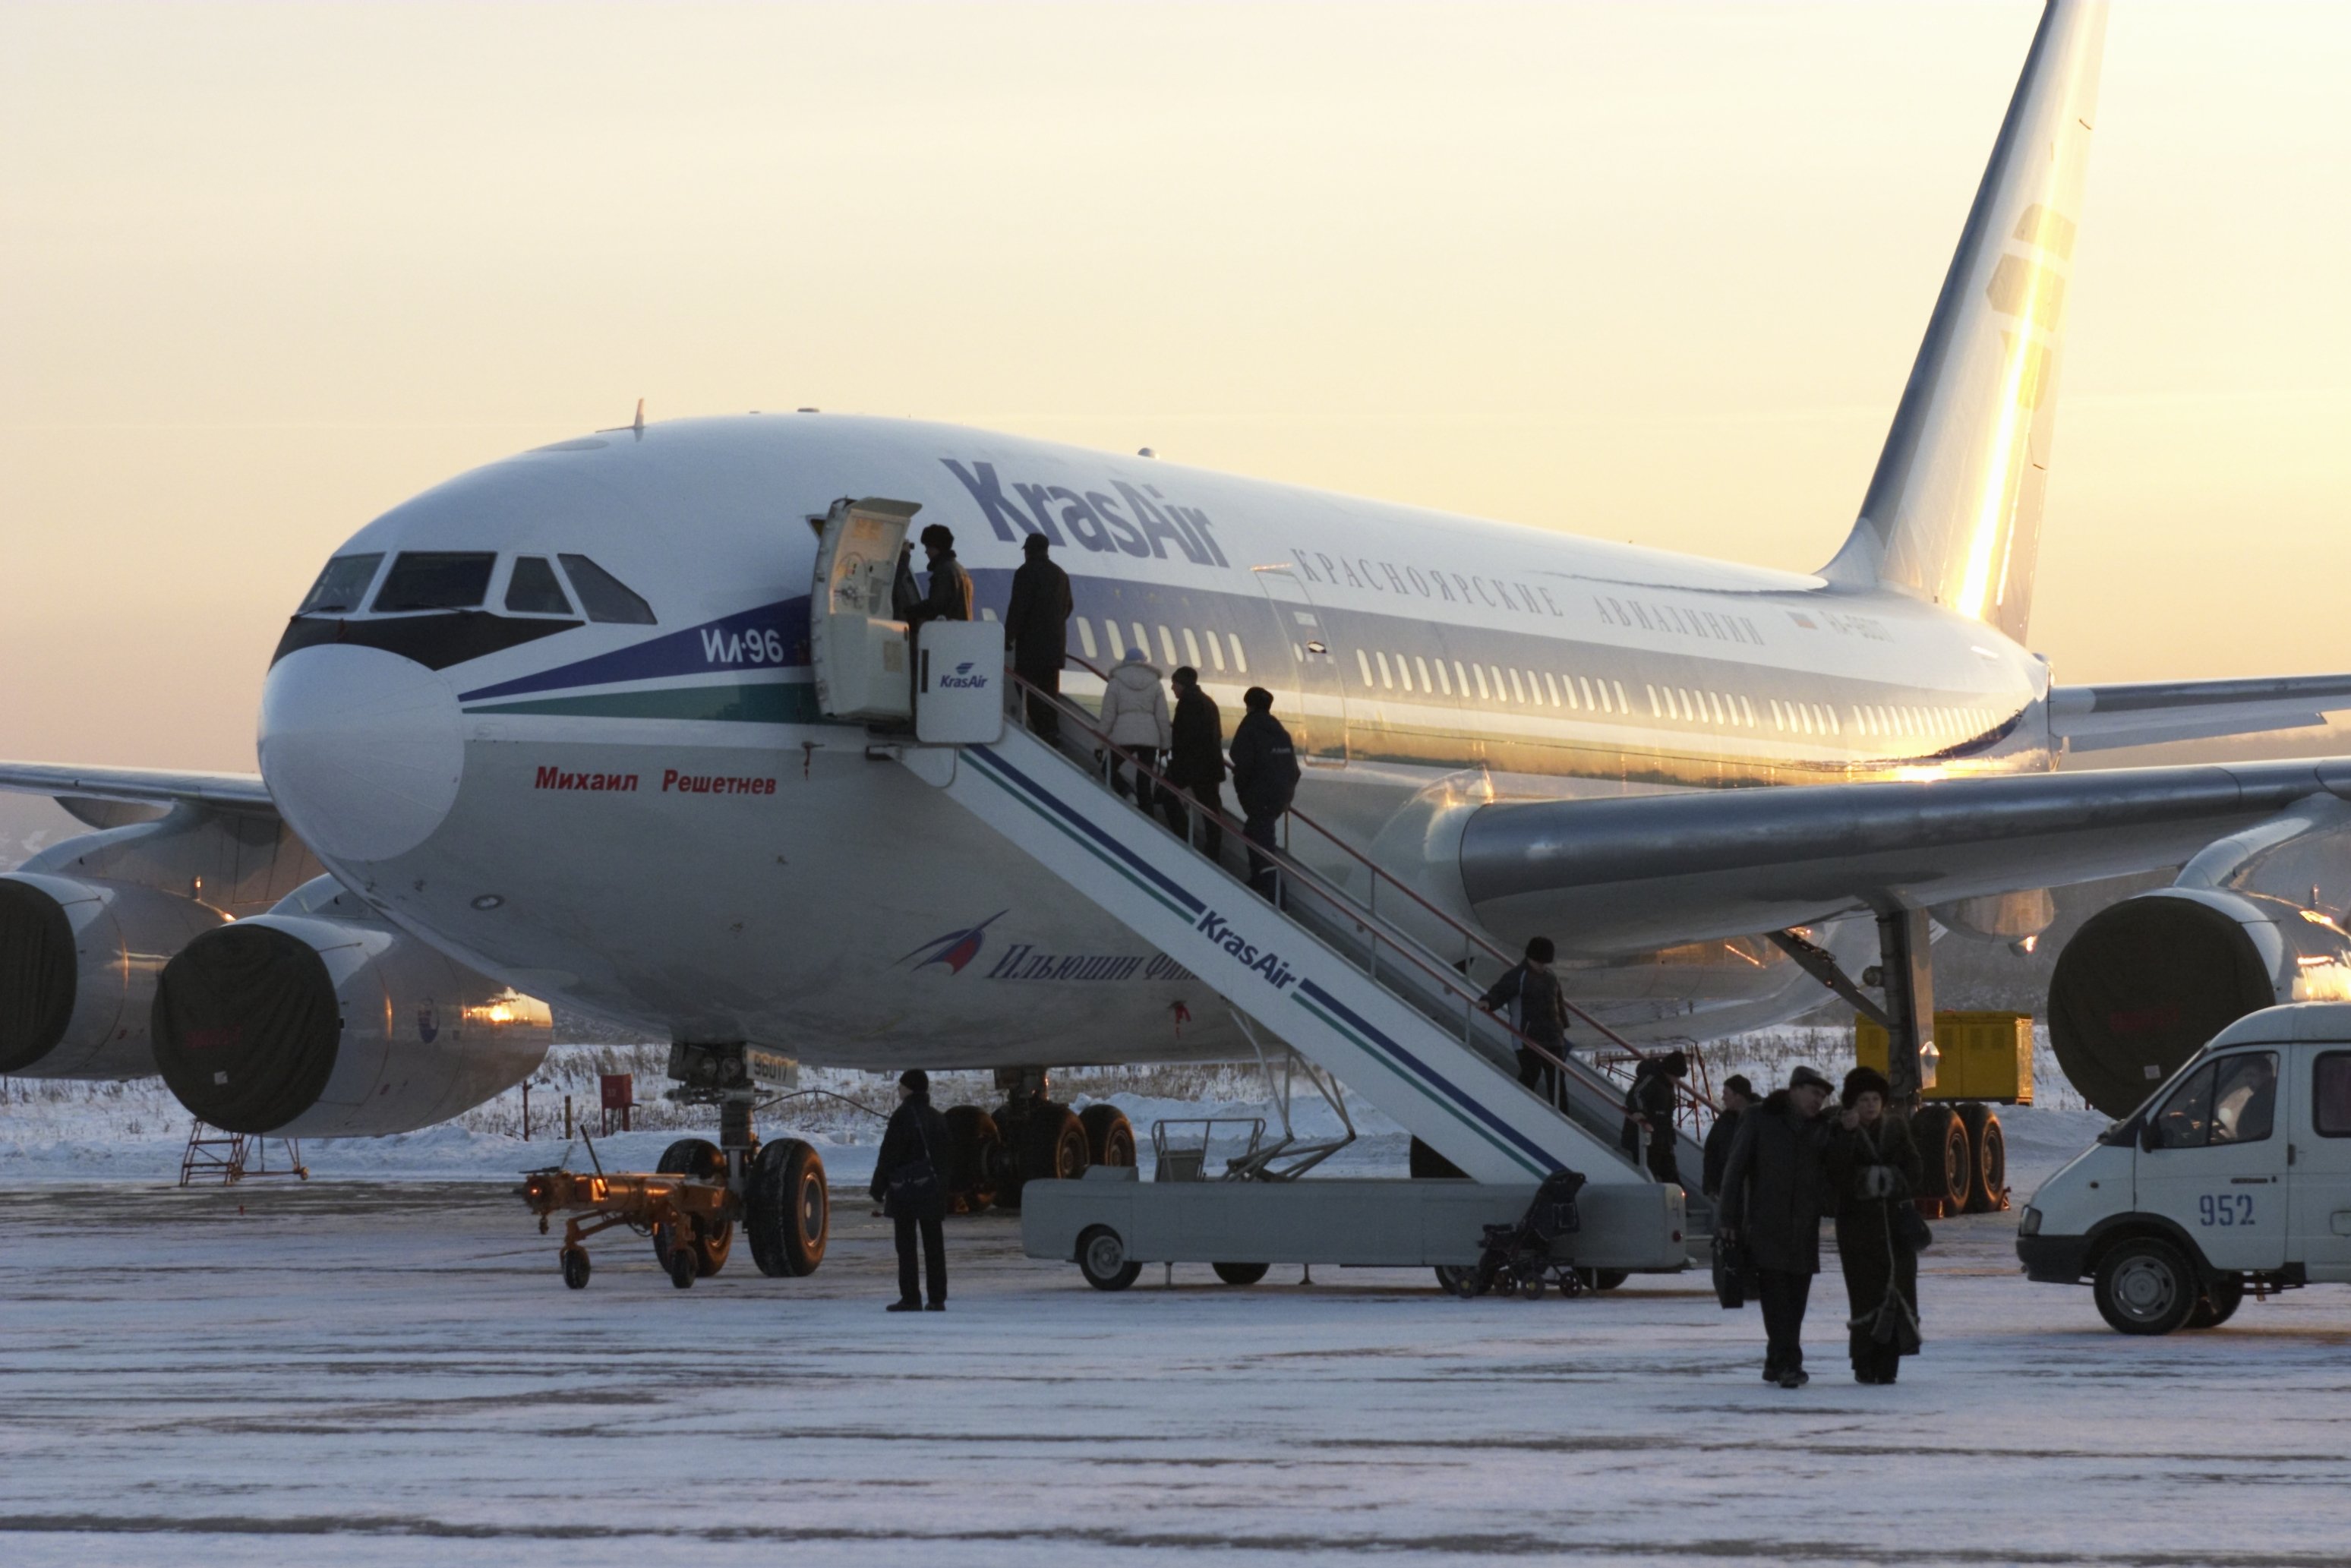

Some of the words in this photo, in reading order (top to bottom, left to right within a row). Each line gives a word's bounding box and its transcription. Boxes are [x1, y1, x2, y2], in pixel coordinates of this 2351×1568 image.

[939, 458, 1230, 568] KrasAir
[1290, 548, 1564, 617] КРАСНОЯРСКИЕ
[940, 674, 989, 688] KrasAir
[534, 765, 639, 792] Михаил
[661, 768, 777, 795] Решетнев
[985, 944, 1145, 980] Ильюшин
[1194, 910, 1297, 989] KrasAir
[753, 1053, 788, 1082] 96017
[2199, 1194, 2255, 1226] 952
